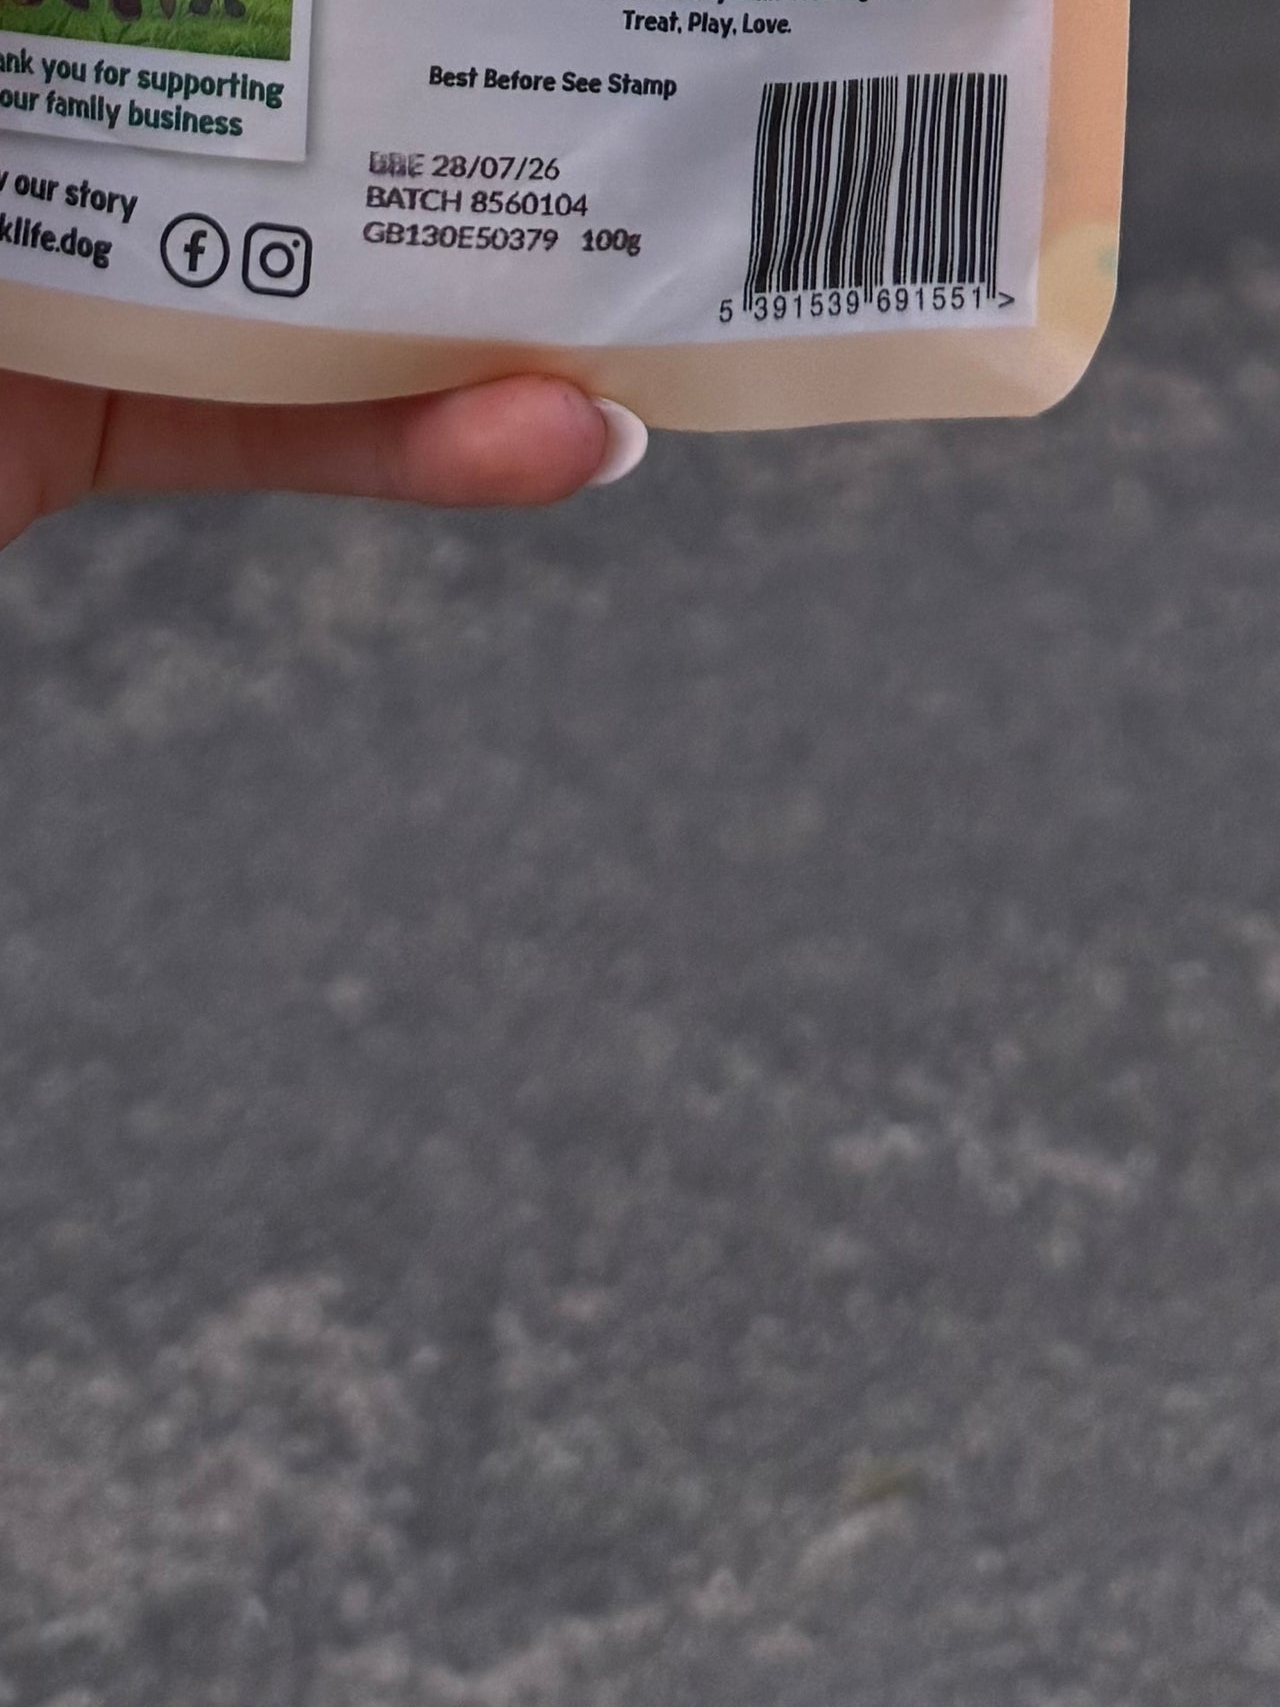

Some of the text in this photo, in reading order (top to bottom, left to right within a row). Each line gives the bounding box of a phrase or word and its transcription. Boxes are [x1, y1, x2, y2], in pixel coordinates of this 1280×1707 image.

[623, 10, 791, 39] Treat, Play, Love.
[42, 58, 86, 84] you
[94, 59, 131, 87] for
[138, 70, 284, 109] supporting
[429, 66, 676, 101] Best Before See Stamp
[0, 89, 243, 136] our family business
[432, 155, 560, 180] 28/07/26
[14, 175, 59, 201] our
[65, 180, 138, 221] story
[366, 186, 588, 216] BATCH 8560104
[363, 221, 641, 257] GB130E50379 100g
[754, 289, 860, 322] 391539
[877, 287, 981, 314] 691551
